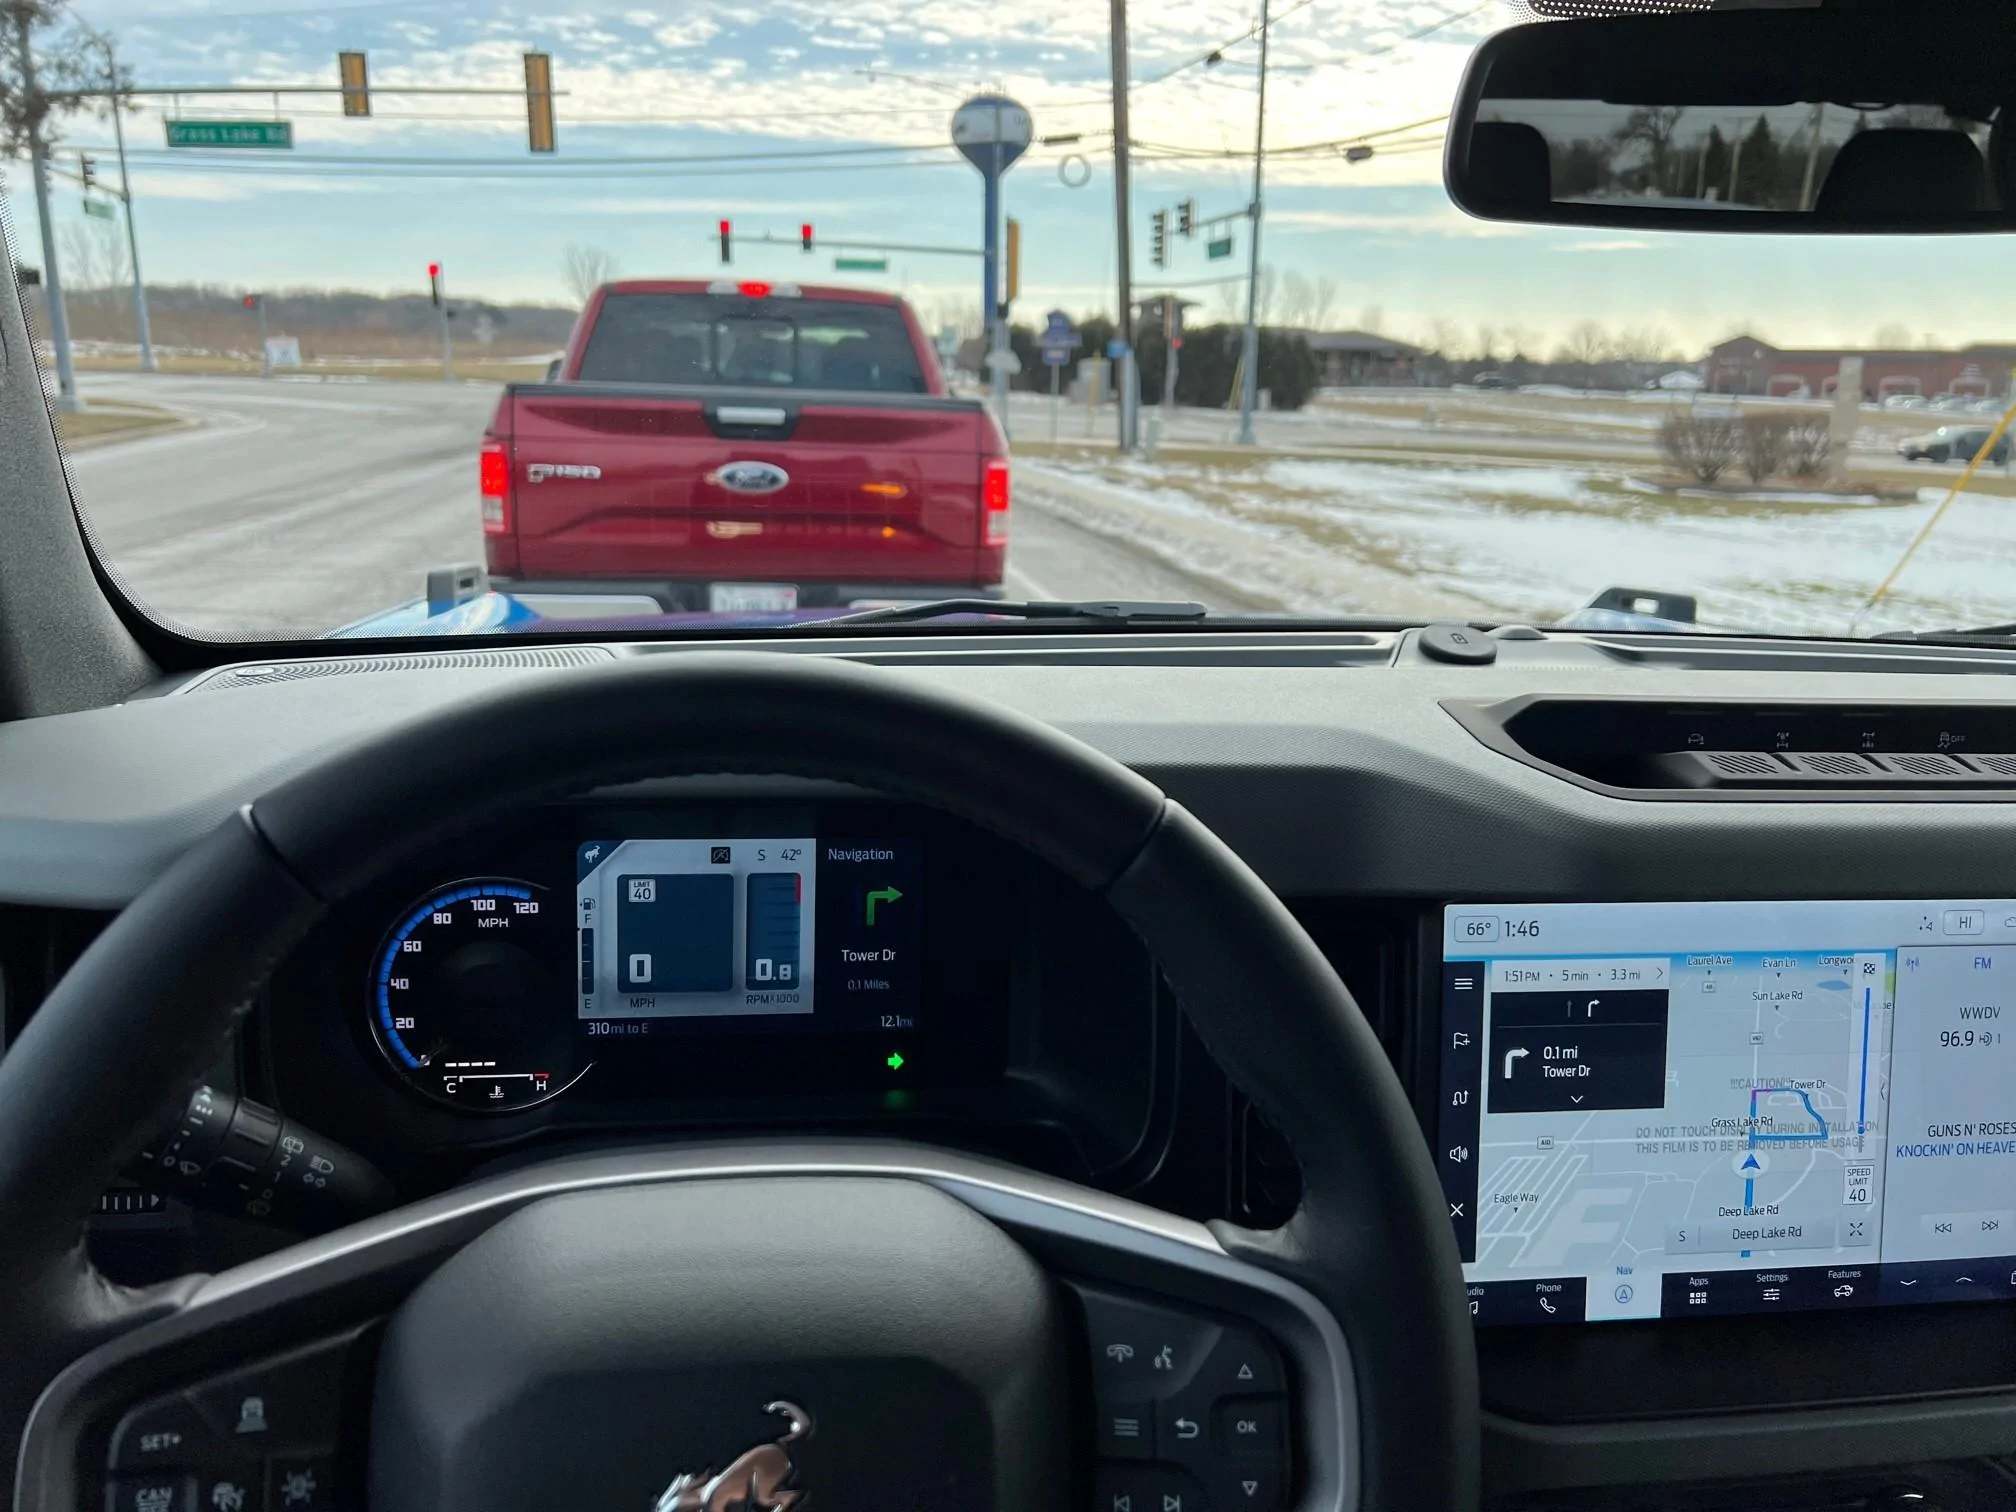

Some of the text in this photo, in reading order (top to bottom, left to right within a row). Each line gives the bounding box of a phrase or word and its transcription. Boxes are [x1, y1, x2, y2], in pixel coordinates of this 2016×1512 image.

[170, 125, 288, 141] Grass Lake Rd
[757, 849, 766, 861] S
[828, 848, 894, 862] Navigation
[633, 880, 651, 888] LIMIT
[633, 888, 651, 900] 40
[471, 900, 496, 911] 100
[513, 902, 539, 914] 120
[433, 913, 452, 925] 80
[478, 918, 509, 928] MPH
[584, 913, 592, 924] F
[1959, 916, 1972, 929] HI
[1504, 920, 1540, 938] 1:46
[403, 941, 422, 952] 60
[842, 949, 896, 962] Tower Dr
[1687, 956, 1733, 966] Laurel Ave
[630, 954, 652, 983] 0
[1762, 958, 1796, 969] Evan Ln
[1974, 957, 1992, 969] FM
[755, 959, 792, 981] 0.8
[1505, 970, 1540, 982] 1:51 PM
[1562, 969, 1589, 981] 5 min
[1610, 968, 1641, 980] 3.3 mi
[390, 978, 409, 989] 40
[848, 979, 890, 990] 0.1 Miles
[1752, 990, 1803, 1001] Sun Lake Rd
[584, 999, 591, 1009] E
[630, 998, 656, 1008] MPH
[1960, 1006, 2000, 1020] WWDV
[395, 1018, 415, 1029] 20
[880, 1015, 900, 1027] 12.1
[588, 1022, 610, 1035] 310
[627, 1023, 639, 1033] to
[641, 1023, 649, 1033] E
[1940, 1030, 1974, 1047] 96.9
[1543, 1046, 1578, 1059] 0.1 mi
[1543, 1065, 1591, 1077] Tower Dr
[446, 1084, 456, 1093] C
[536, 1081, 546, 1091] H
[1790, 1080, 1826, 1089] Tower Dr
[1711, 1116, 1773, 1127] Grass Lake Rd
[1636, 1127, 1650, 1138] DO
[1654, 1127, 1676, 1138] NOT
[1681, 1126, 1716, 1137] TOUCH
[1767, 1123, 1805, 1134] DURING
[1927, 1124, 1961, 1137] GUNS
[1964, 1123, 1976, 1136] N'
[1637, 1142, 1659, 1153] THIS
[1662, 1142, 1686, 1153] FILM
[1689, 1141, 1699, 1152] IS
[1702, 1141, 1717, 1152] TO
[1720, 1140, 1734, 1151] BE
[1789, 1138, 1828, 1149] BEFORE
[1896, 1140, 2016, 1158] KNOCKIN' ON HEAVE
[1847, 1168, 1871, 1177] SPEED
[1848, 1178, 1868, 1187] LIMIT
[1494, 1192, 1539, 1204] Eagle Way
[1848, 1189, 1867, 1202] 40
[1718, 1204, 1779, 1217] Deep Lake Rd
[1679, 1230, 1686, 1242] S
[1732, 1226, 1802, 1241] Deep Lake Rd
[1616, 1266, 1633, 1275] Nav
[1828, 1270, 1861, 1279] Features
[1689, 1276, 1709, 1286] Apps
[1756, 1273, 1788, 1283] Settings
[1536, 1283, 1562, 1293] Phone
[1236, 1420, 1257, 1433] OK
